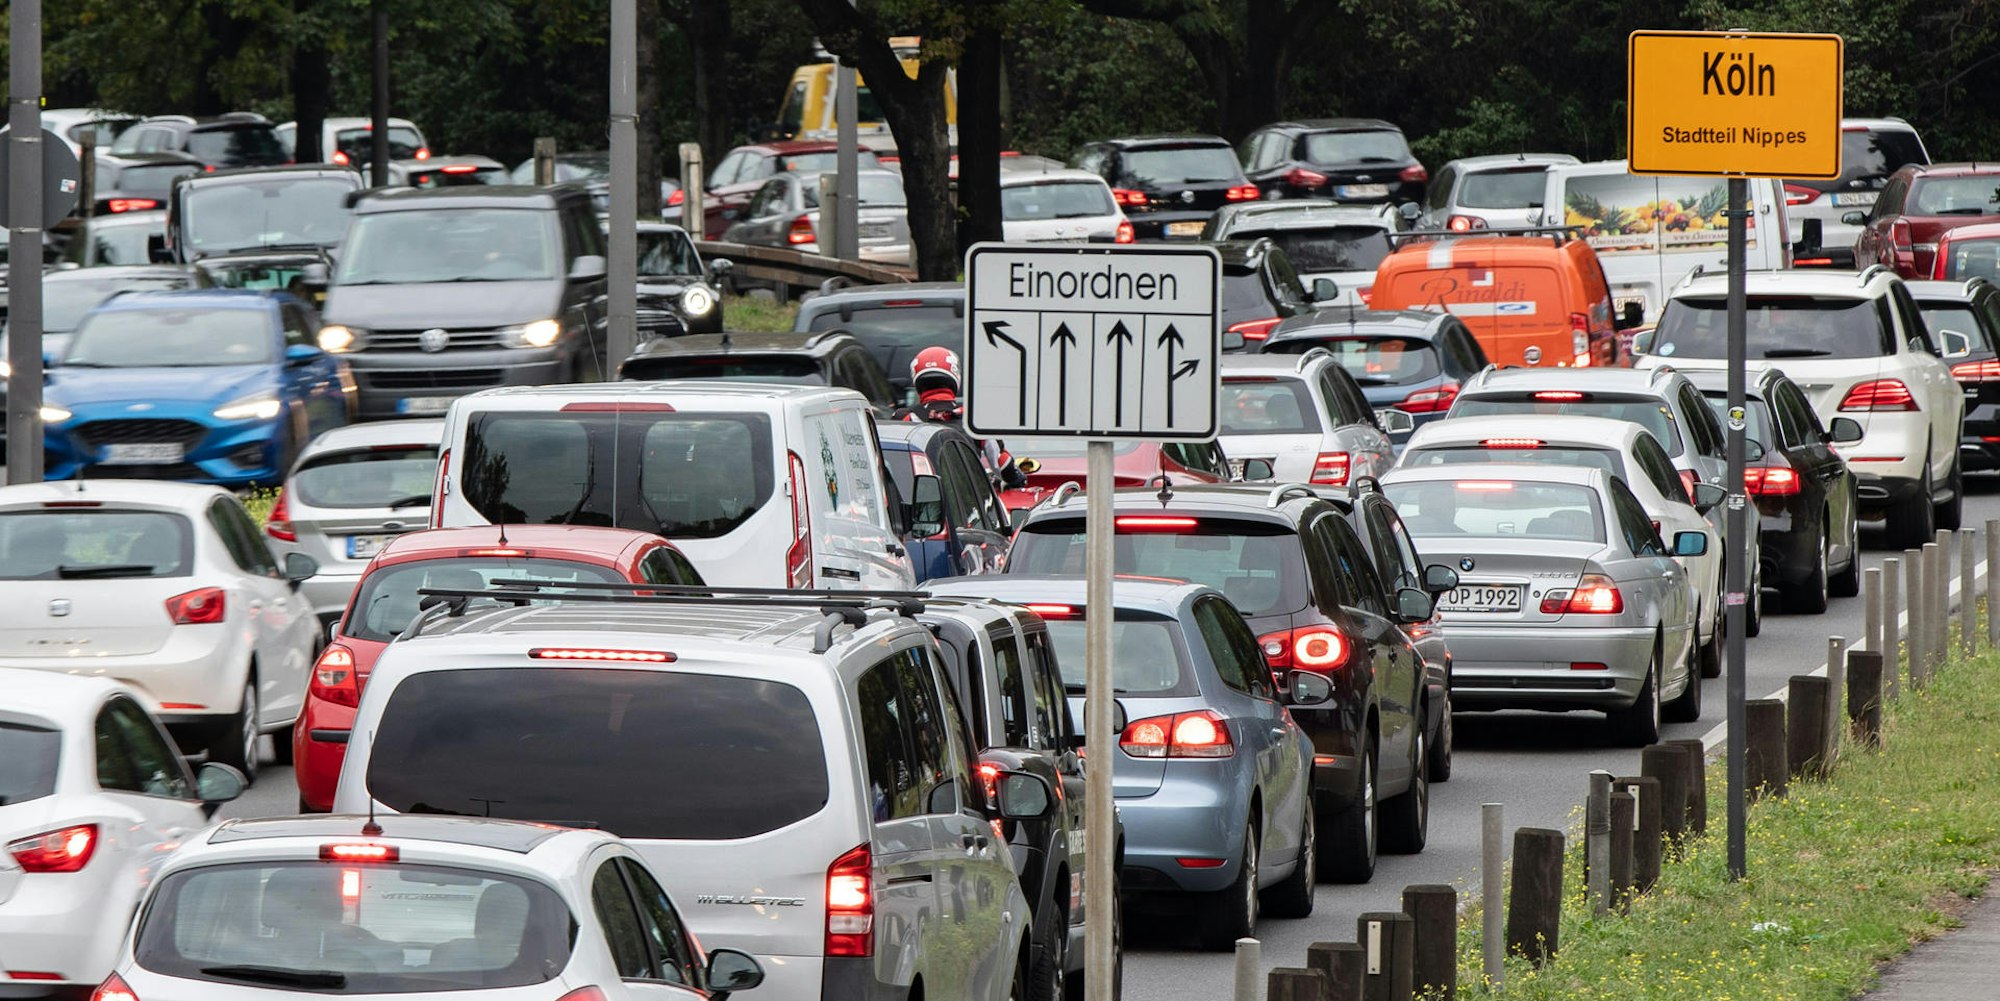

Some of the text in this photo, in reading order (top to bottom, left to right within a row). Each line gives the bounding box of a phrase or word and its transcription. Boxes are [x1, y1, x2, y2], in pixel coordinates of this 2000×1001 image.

[1703, 52, 1775, 96] Köln
[1662, 126, 1807, 148] Stadtteil Nippes
[1010, 263, 1177, 300] Einordnen
[1420, 271, 1526, 314] Rinaldi
[1448, 588, 1518, 606] OP 1992
